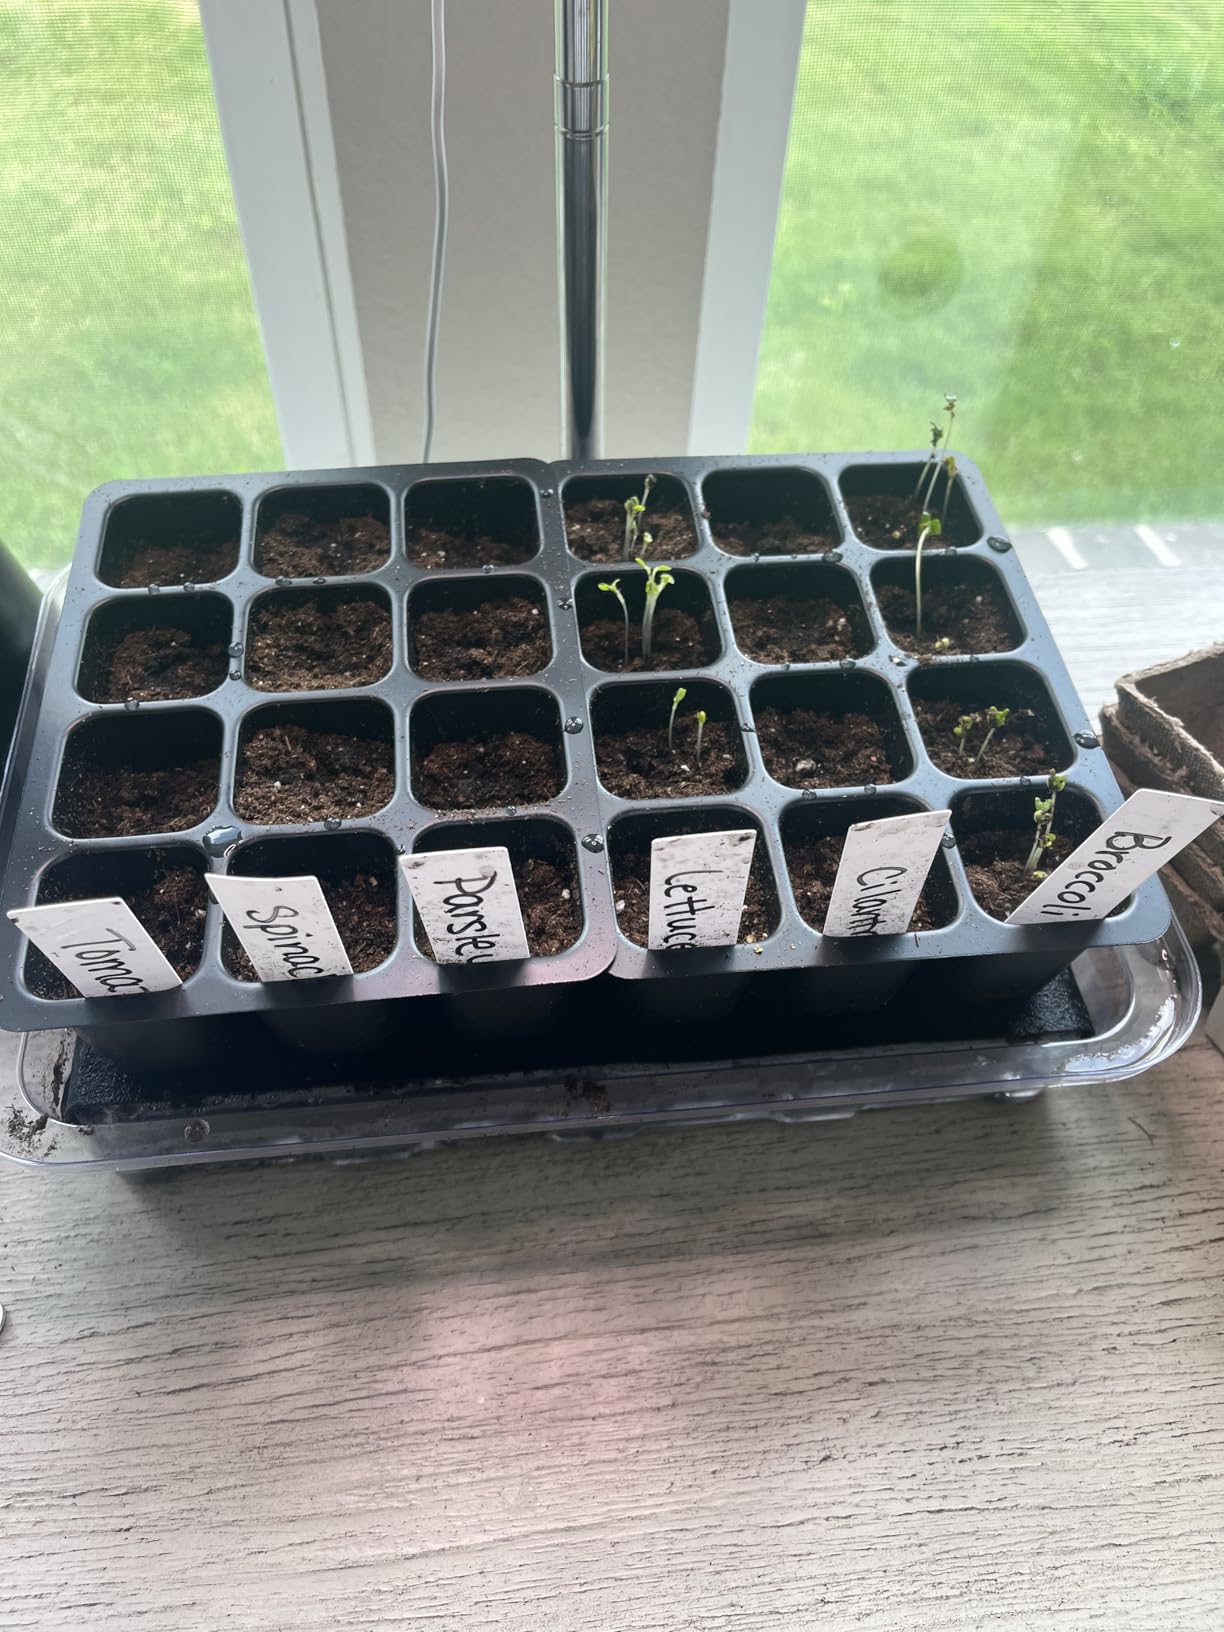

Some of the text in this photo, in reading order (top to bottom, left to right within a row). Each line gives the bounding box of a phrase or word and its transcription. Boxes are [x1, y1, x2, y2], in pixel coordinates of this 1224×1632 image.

[847, 866, 907, 936] Cilantr
[1040, 831, 1172, 916] Broccoli
[61, 927, 149, 993] Toma
[242, 905, 337, 978] Spinac
